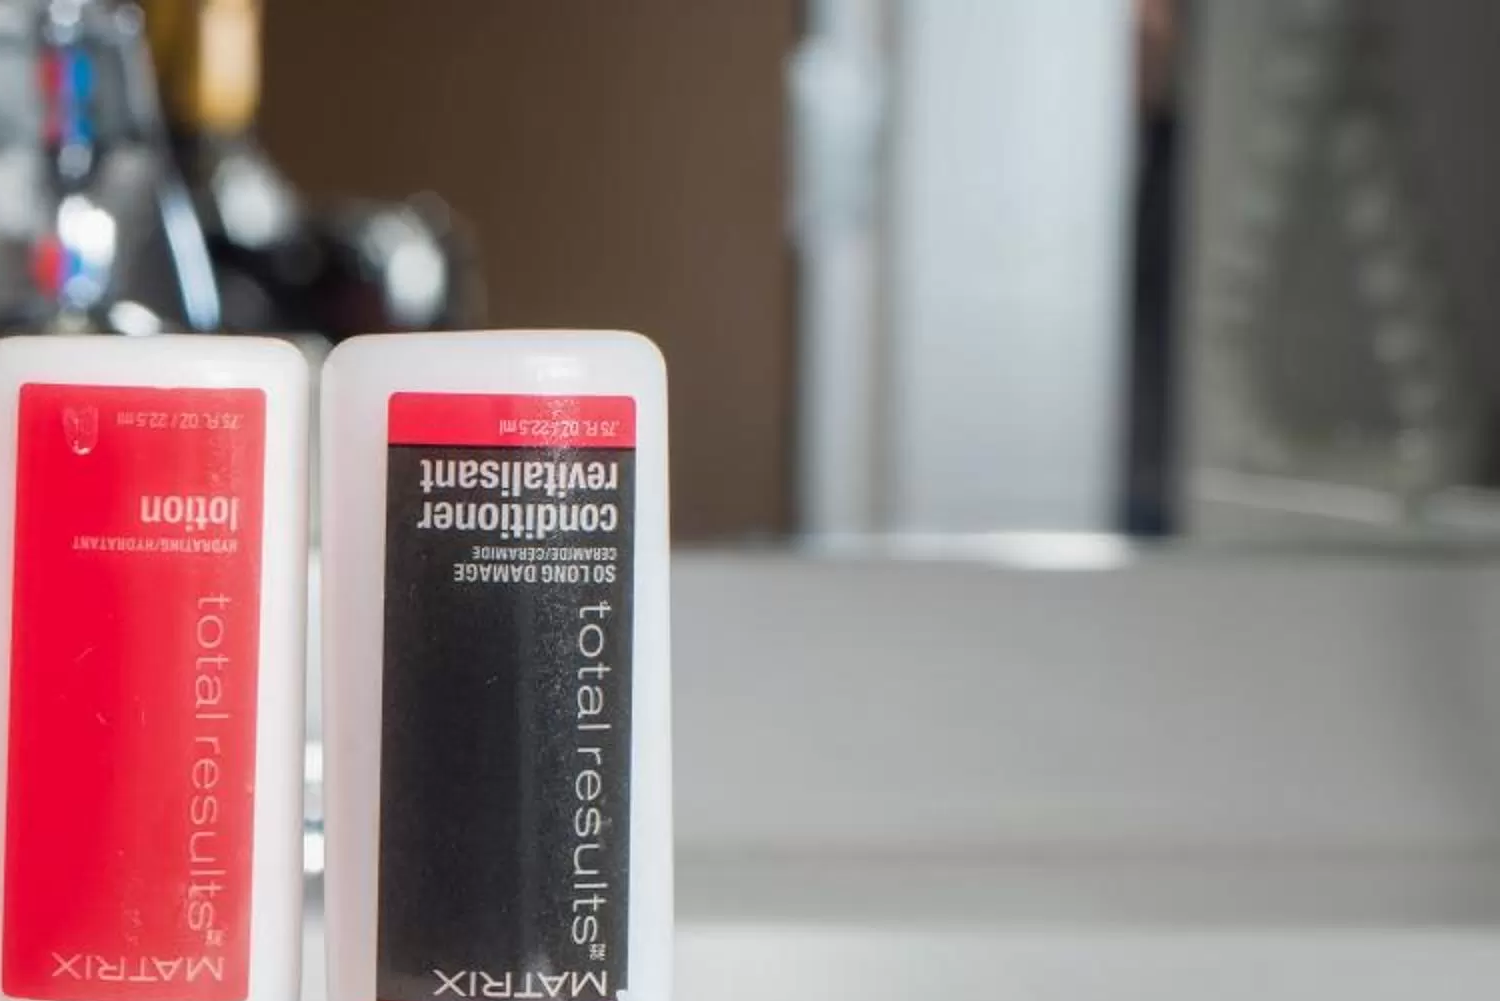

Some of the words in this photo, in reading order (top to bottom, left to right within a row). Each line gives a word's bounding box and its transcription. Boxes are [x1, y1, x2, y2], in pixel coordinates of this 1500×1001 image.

[499, 420, 517, 436] ml
[419, 459, 618, 498] revitalisant
[139, 495, 240, 532] lotion
[417, 501, 618, 540] conditioner
[454, 563, 537, 582] DAMAGE
[541, 563, 589, 583] LONG
[593, 564, 616, 582] SO
[195, 593, 232, 719] total
[576, 600, 612, 731] total
[187, 736, 227, 932] results
[572, 746, 609, 945] results
[51, 952, 225, 982] MATRIX
[432, 969, 607, 998] MATRIX
